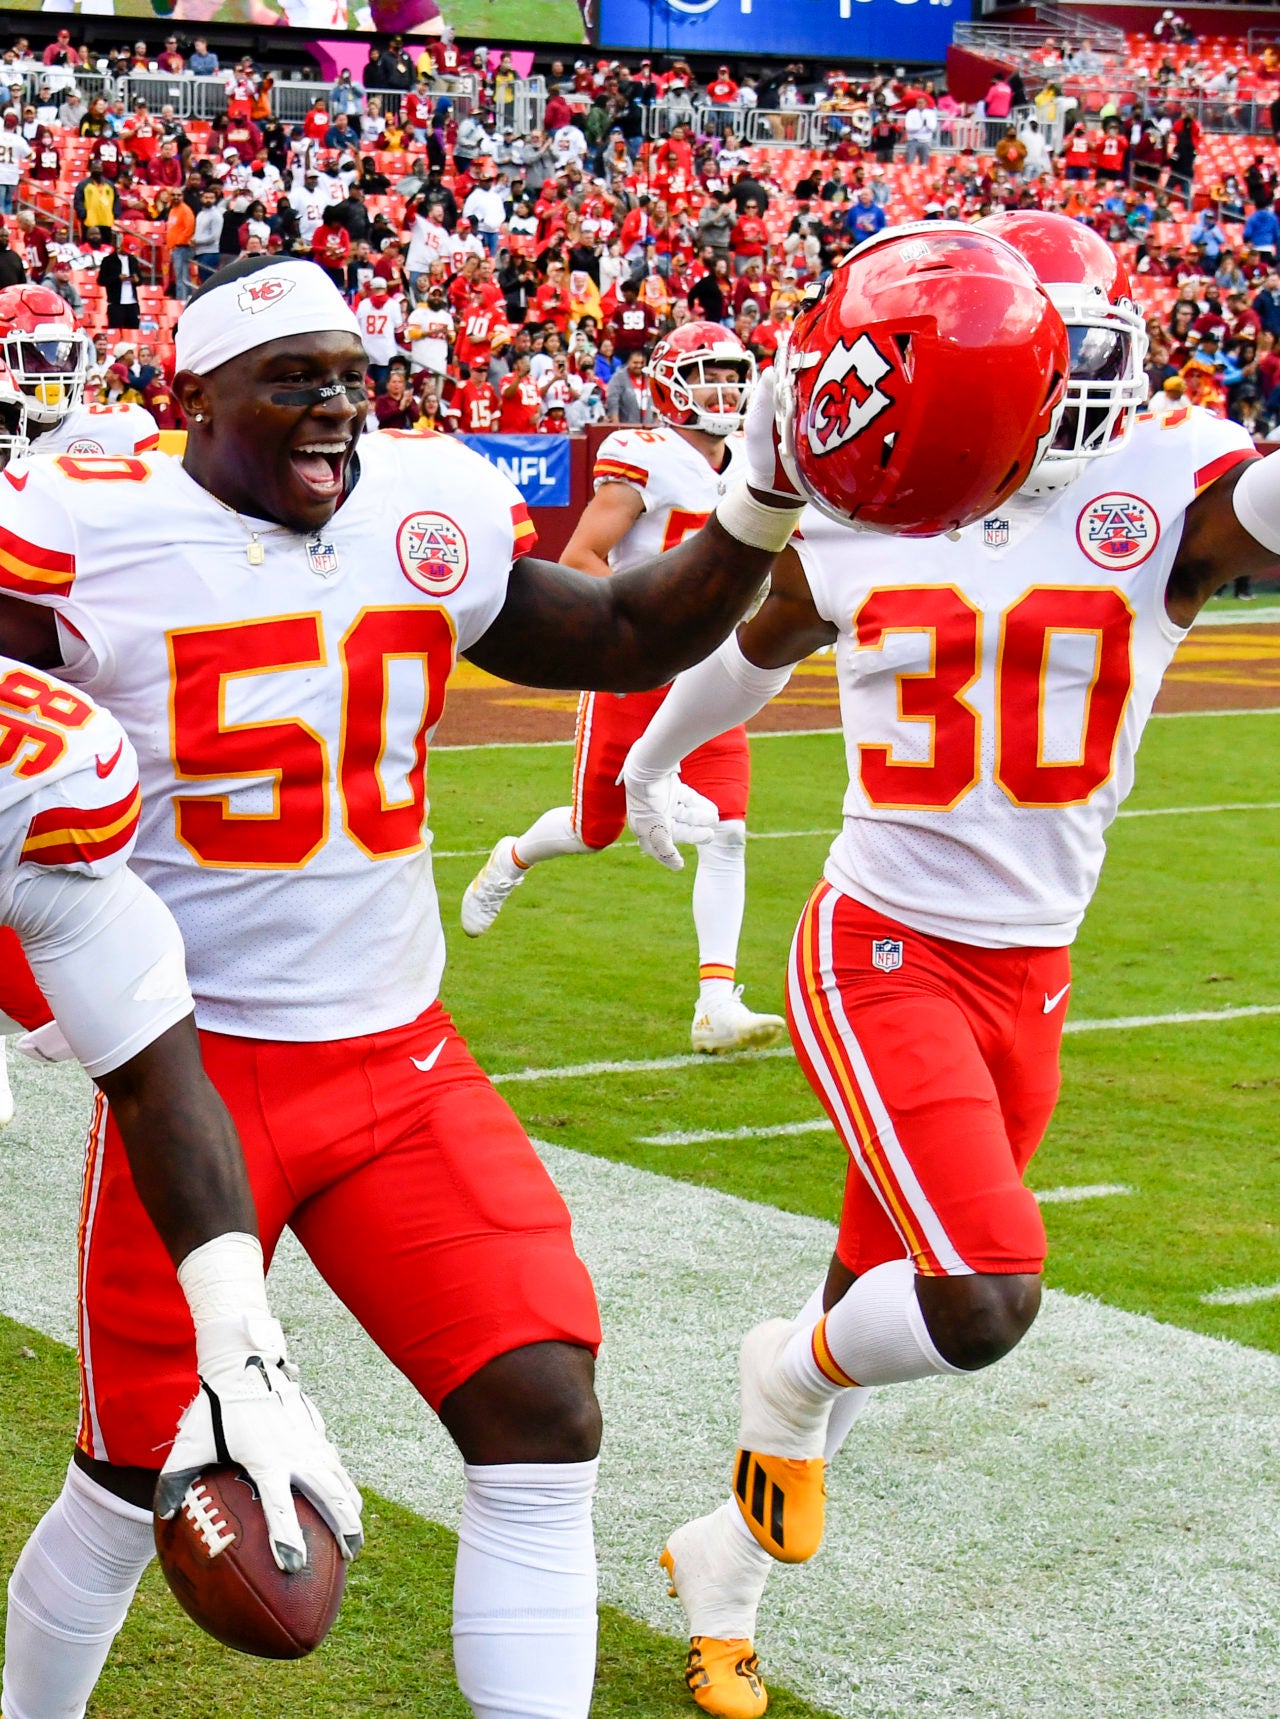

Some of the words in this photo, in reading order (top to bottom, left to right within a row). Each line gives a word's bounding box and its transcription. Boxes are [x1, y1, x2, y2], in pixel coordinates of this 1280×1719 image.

[366, 315, 387, 334] 87
[467, 316, 488, 337] 10
[623, 311, 645, 330] 99
[470, 400, 491, 428] 15
[497, 457, 557, 486] NFL
[986, 531, 1006, 543] NFL
[314, 557, 335, 570] NFL
[853, 582, 1136, 811] 30
[165, 603, 457, 869] 50
[877, 953, 896, 965] NFL
